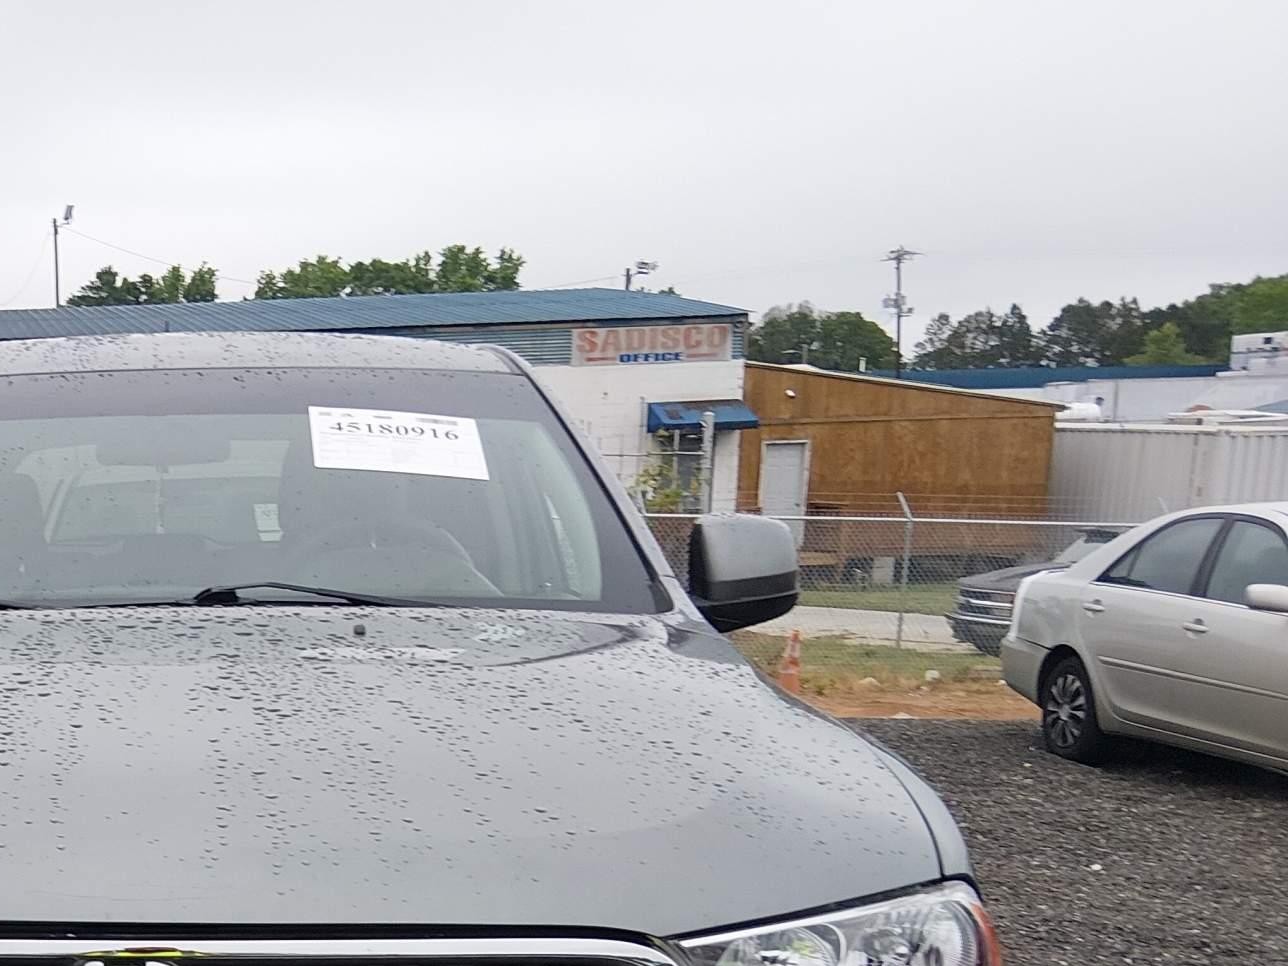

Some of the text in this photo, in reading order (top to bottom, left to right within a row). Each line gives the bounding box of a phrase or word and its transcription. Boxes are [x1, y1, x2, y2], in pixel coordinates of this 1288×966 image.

[576, 325, 730, 354] SADISCO
[618, 351, 683, 364] OFFICE
[328, 421, 460, 441] 45180916
